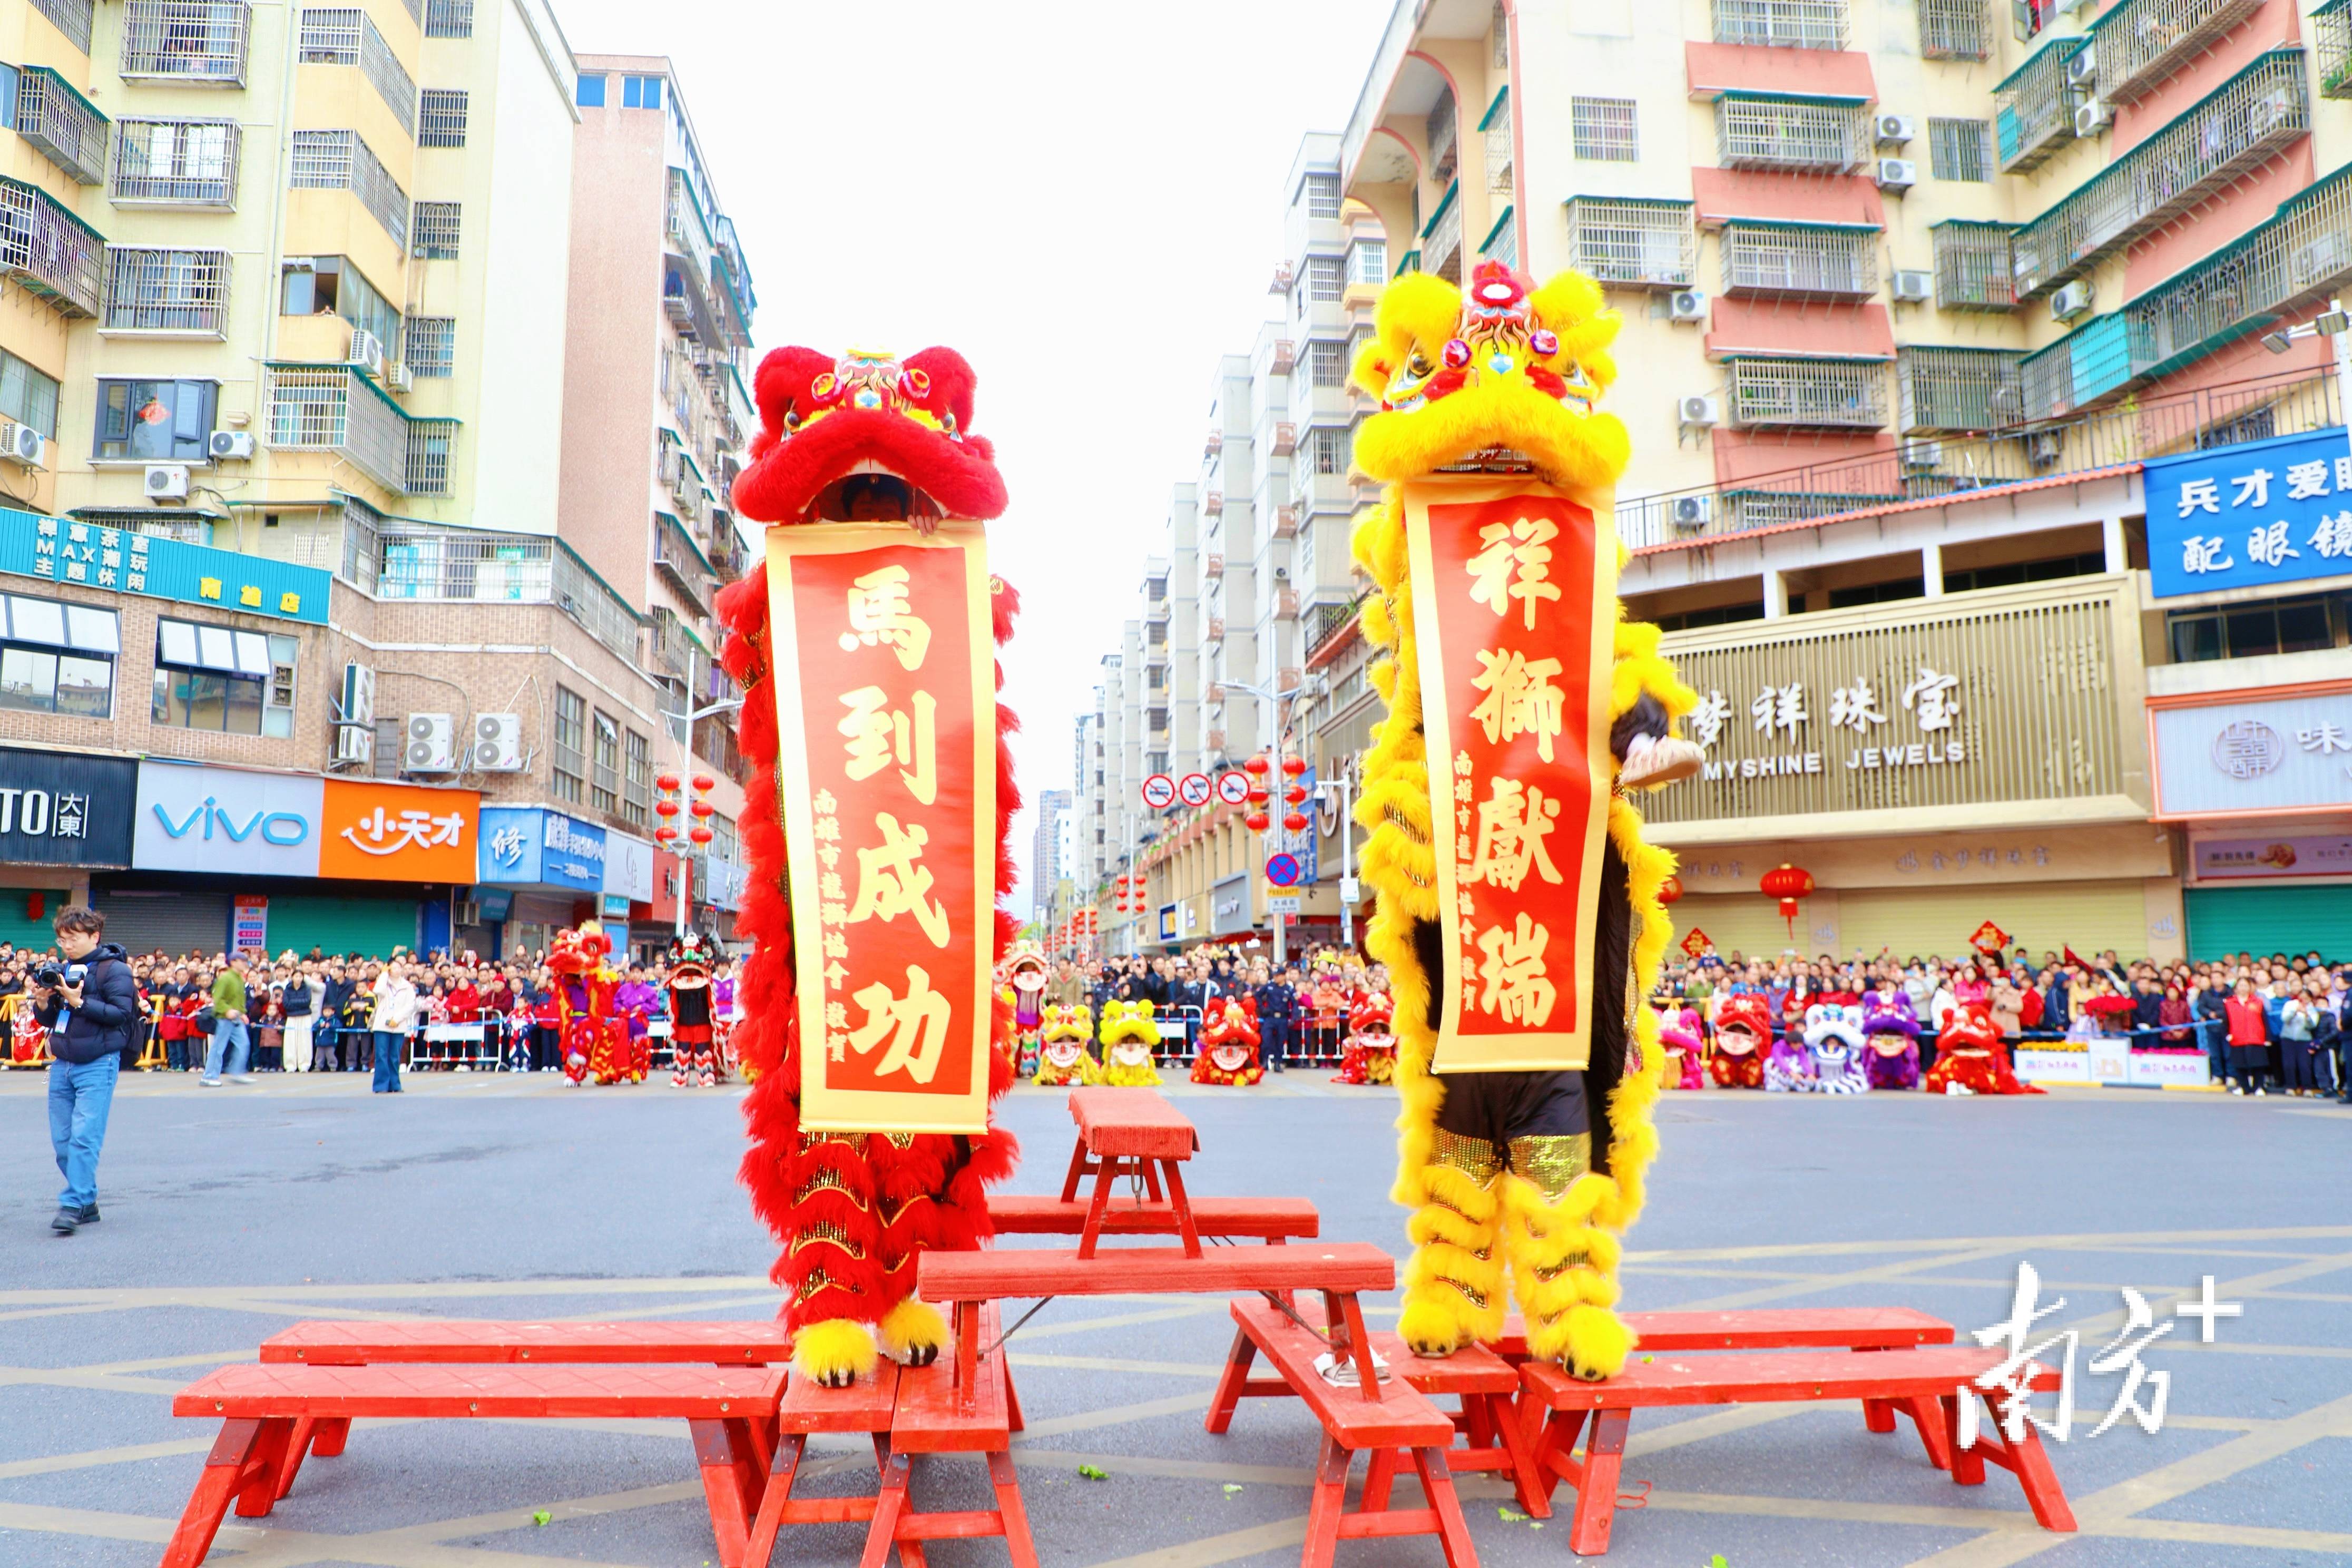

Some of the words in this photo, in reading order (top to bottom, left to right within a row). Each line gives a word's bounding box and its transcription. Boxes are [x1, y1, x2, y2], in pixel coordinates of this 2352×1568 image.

[38, 518, 150, 554] 禅意茶室
[2182, 510, 2352, 574] 配眼镜
[34, 557, 145, 591] 主题休闲
[1689, 668, 1960, 749] 梦祥珠宝
[1704, 752, 1821, 781] MYSHINE
[1847, 742, 1964, 769] JEWELS
[2296, 721, 2352, 754] 味
[1465, 517, 1565, 1027] 祥獅獻瑞
[154, 796, 309, 846] vivo
[341, 807, 465, 855] 小天才
[838, 565, 952, 1084] 馬到成功
[491, 827, 527, 867] 修
